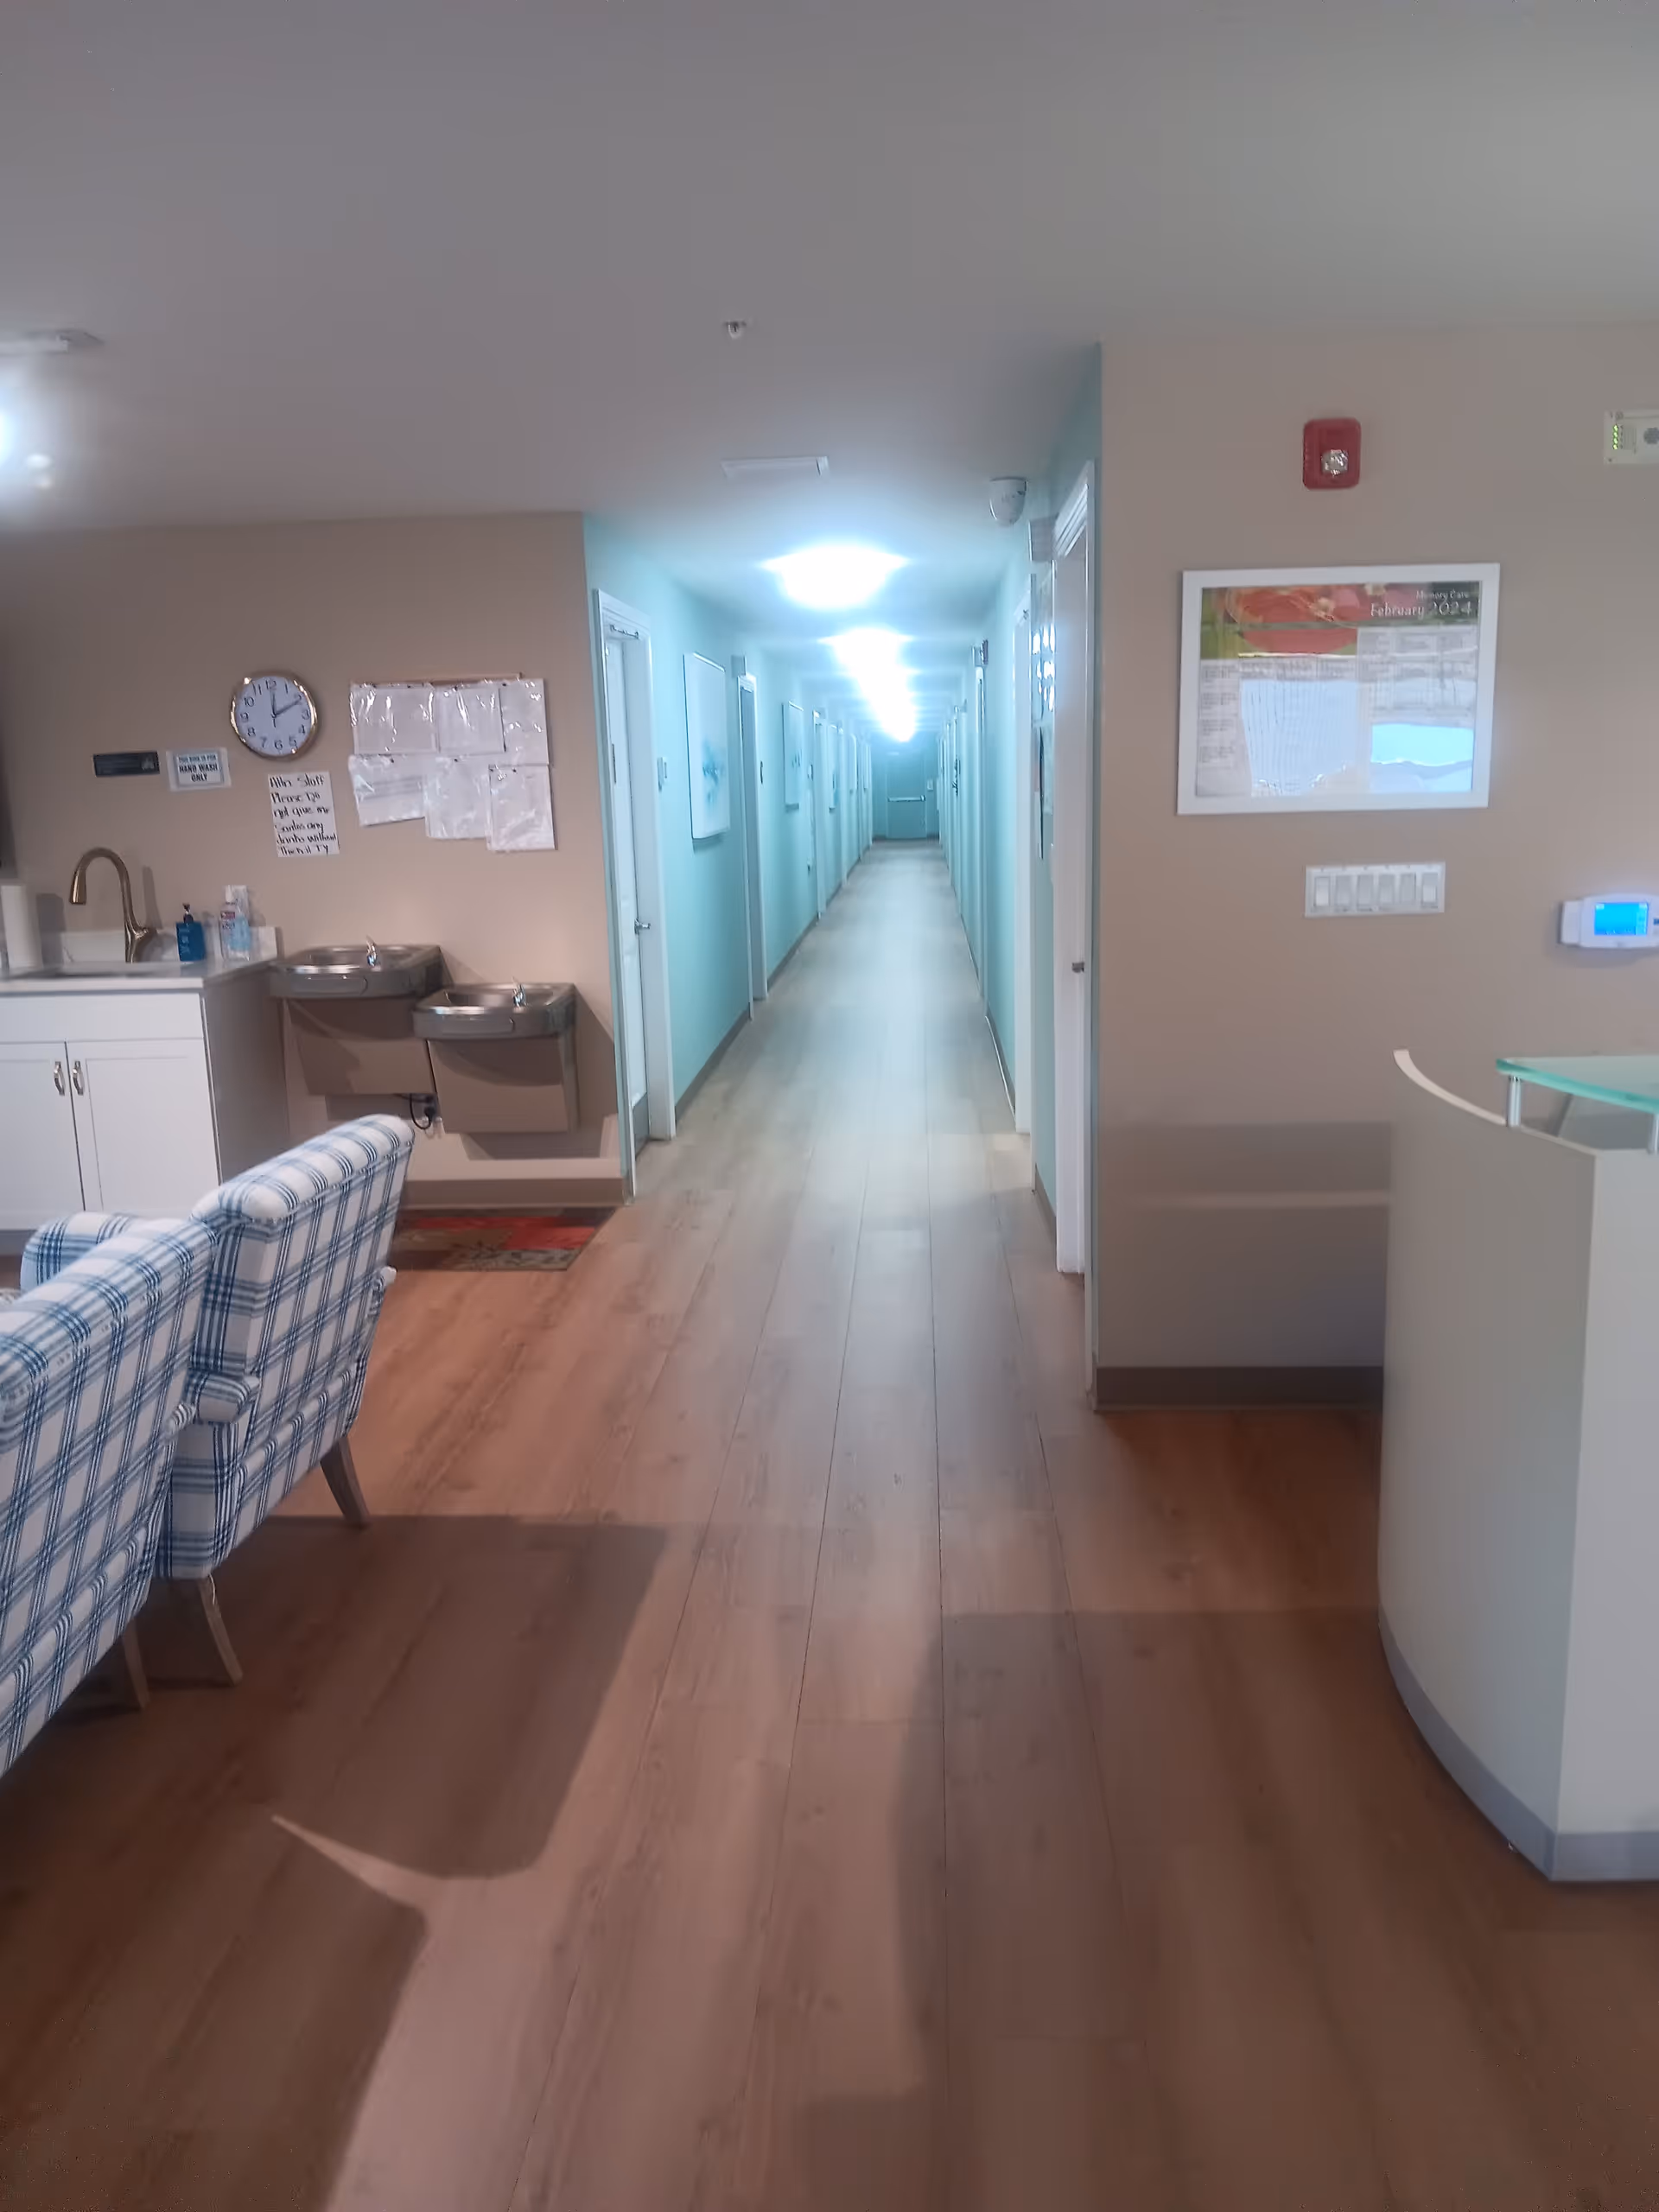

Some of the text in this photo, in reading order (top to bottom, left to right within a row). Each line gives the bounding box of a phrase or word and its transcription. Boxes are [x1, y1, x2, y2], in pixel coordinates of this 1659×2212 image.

[1370, 602, 1471, 620] February 2024
[251, 682, 262, 696] 11
[265, 678, 276, 690] 12
[244, 696, 255, 707] 10
[240, 712, 250, 723] 9
[301, 709, 310, 720] 3
[247, 727, 256, 737] 8
[298, 724, 306, 734] 4
[260, 736, 267, 748] 7
[274, 740, 283, 750] 6
[289, 735, 298, 749] 5
[179, 762, 218, 773] HAND WASH
[191, 772, 208, 782] ONLY
[270, 791, 302, 804] Please
[306, 823, 324, 834] any
